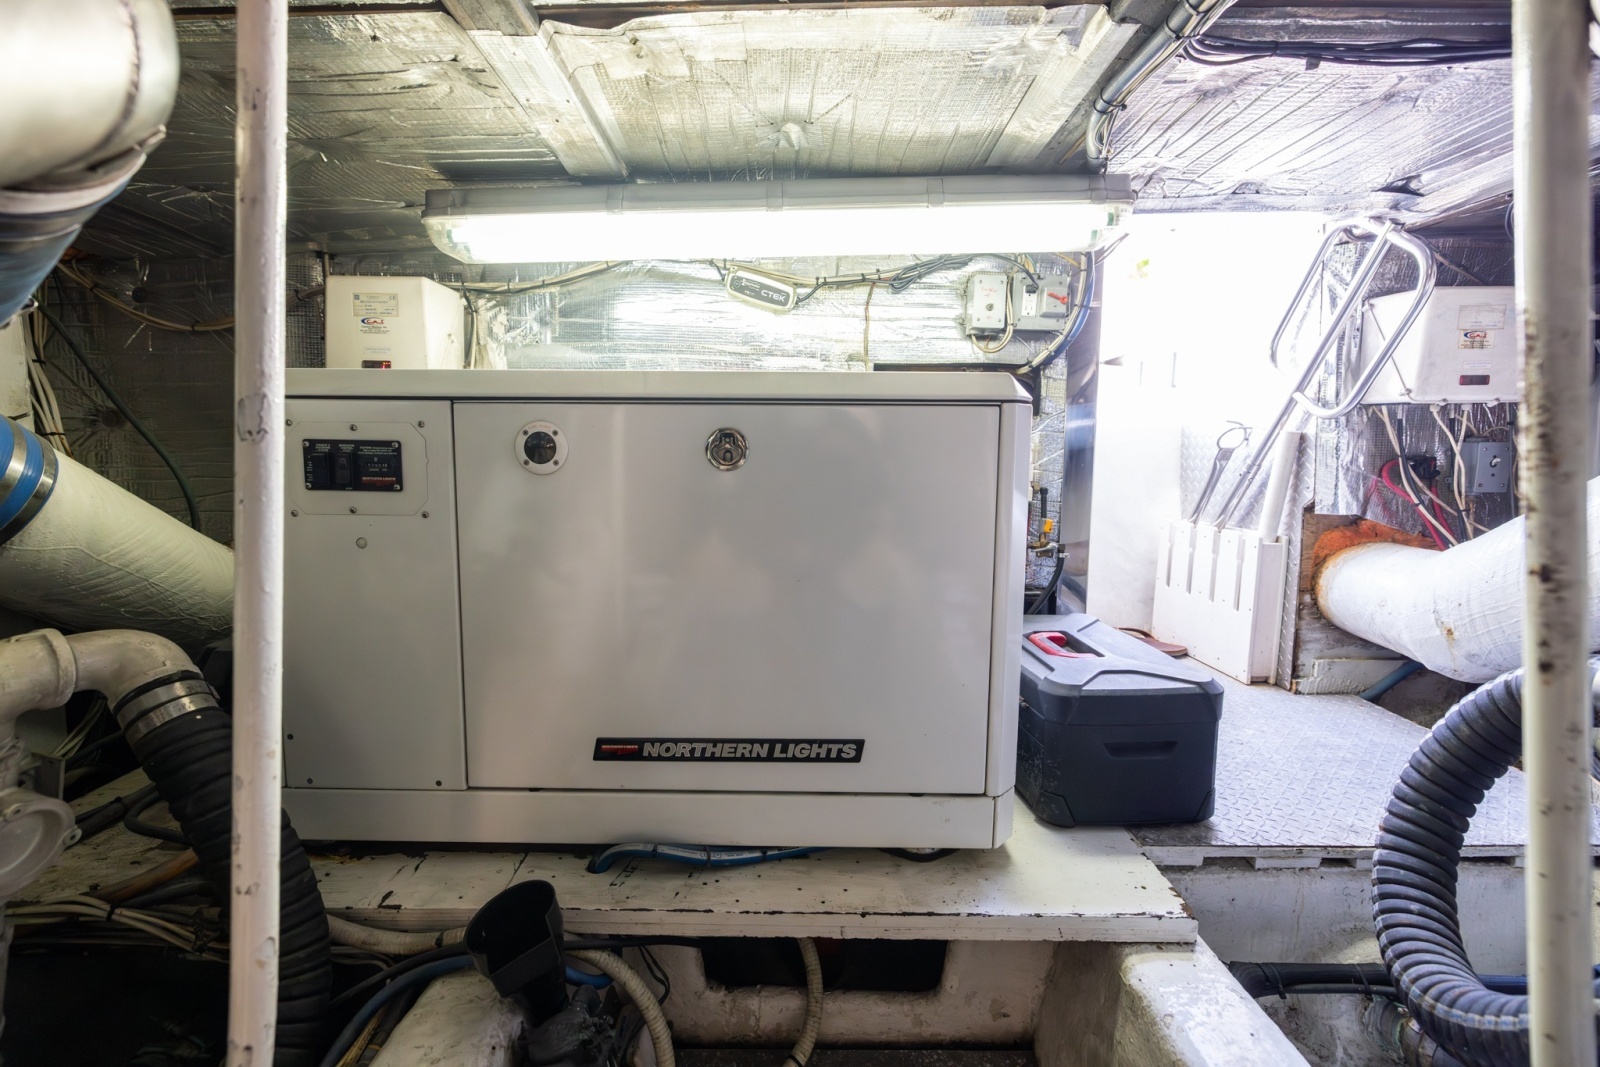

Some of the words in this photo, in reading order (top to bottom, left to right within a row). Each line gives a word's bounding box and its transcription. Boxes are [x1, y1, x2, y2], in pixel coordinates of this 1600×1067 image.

[761, 289, 786, 302] CTEK
[642, 742, 770, 758] NORTHERN
[773, 743, 857, 759] LIGHTS
